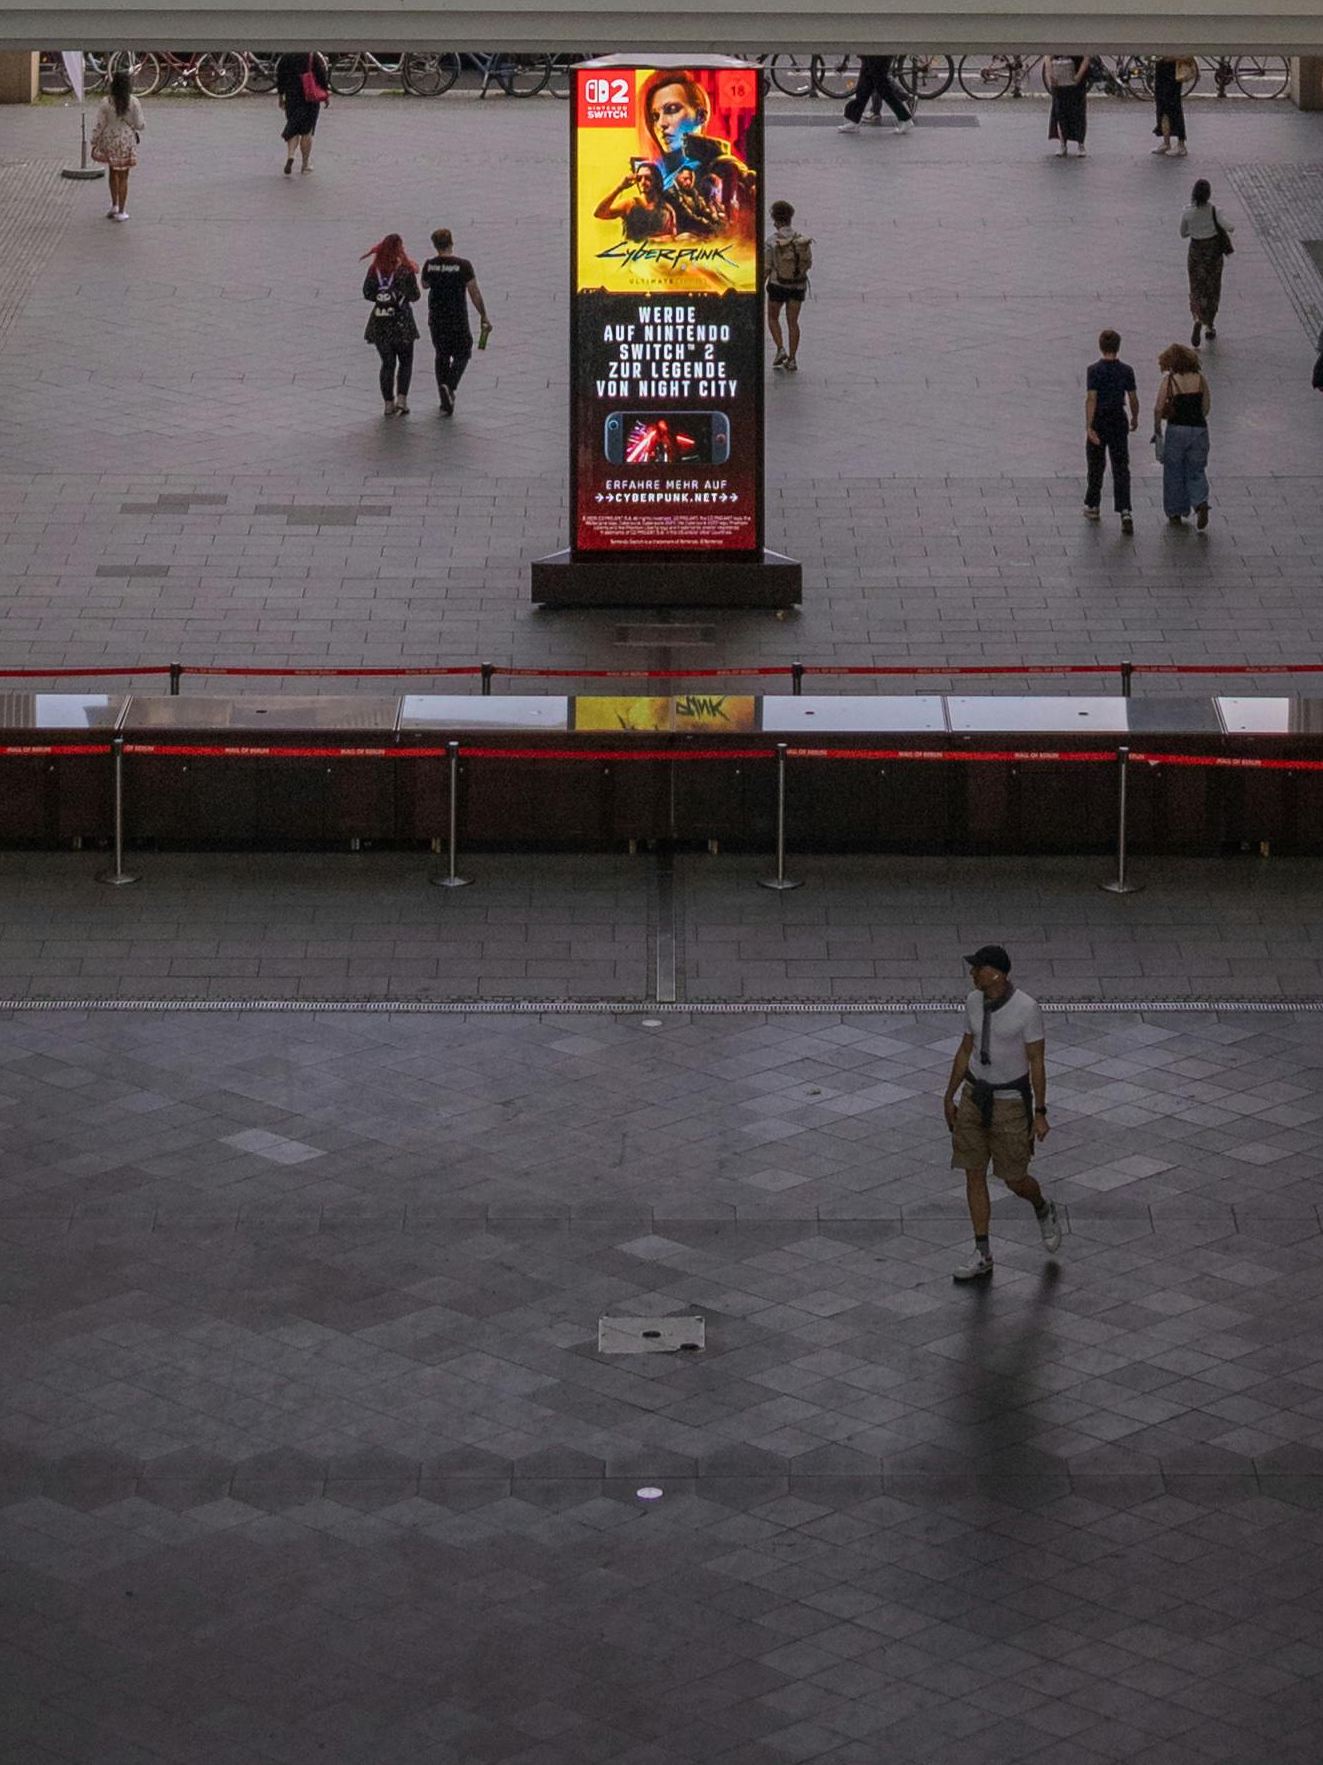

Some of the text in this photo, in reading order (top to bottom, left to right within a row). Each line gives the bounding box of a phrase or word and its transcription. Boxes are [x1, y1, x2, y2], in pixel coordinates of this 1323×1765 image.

[611, 79, 629, 103] 2
[730, 84, 746, 97] 18
[587, 111, 628, 119] SWITCH
[638, 306, 696, 323] WERDE
[604, 325, 730, 342] AUF NINTENDO
[704, 343, 714, 360] 2
[609, 362, 726, 378] ZUR LEGENDE
[596, 380, 737, 397] VON NIGHT CITY
[606, 479, 728, 490] ERFAHRE MEHR AUF
